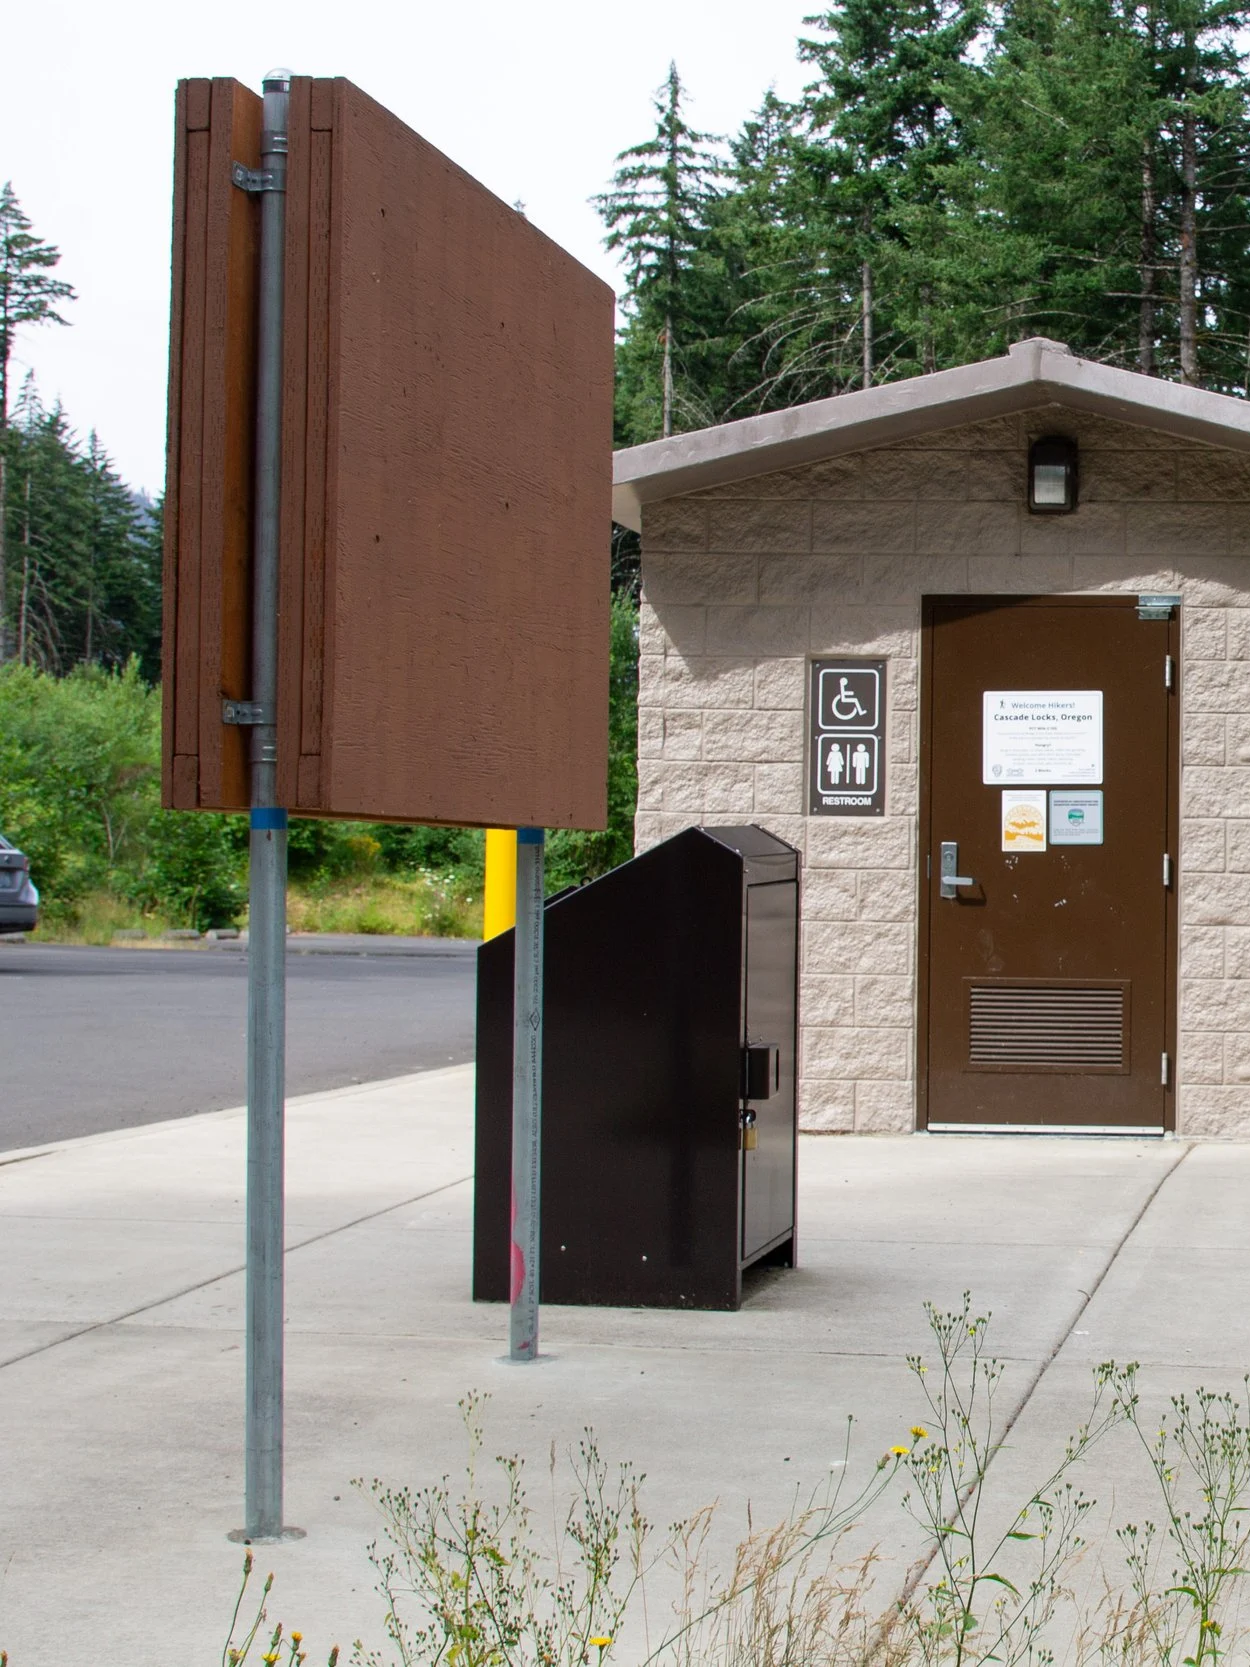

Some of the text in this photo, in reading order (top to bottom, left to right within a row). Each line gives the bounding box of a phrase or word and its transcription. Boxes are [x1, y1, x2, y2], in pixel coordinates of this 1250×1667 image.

[1031, 714, 1059, 722] Locks,
[1061, 714, 1093, 723] Oregon
[822, 796, 872, 806] RESTROOM
